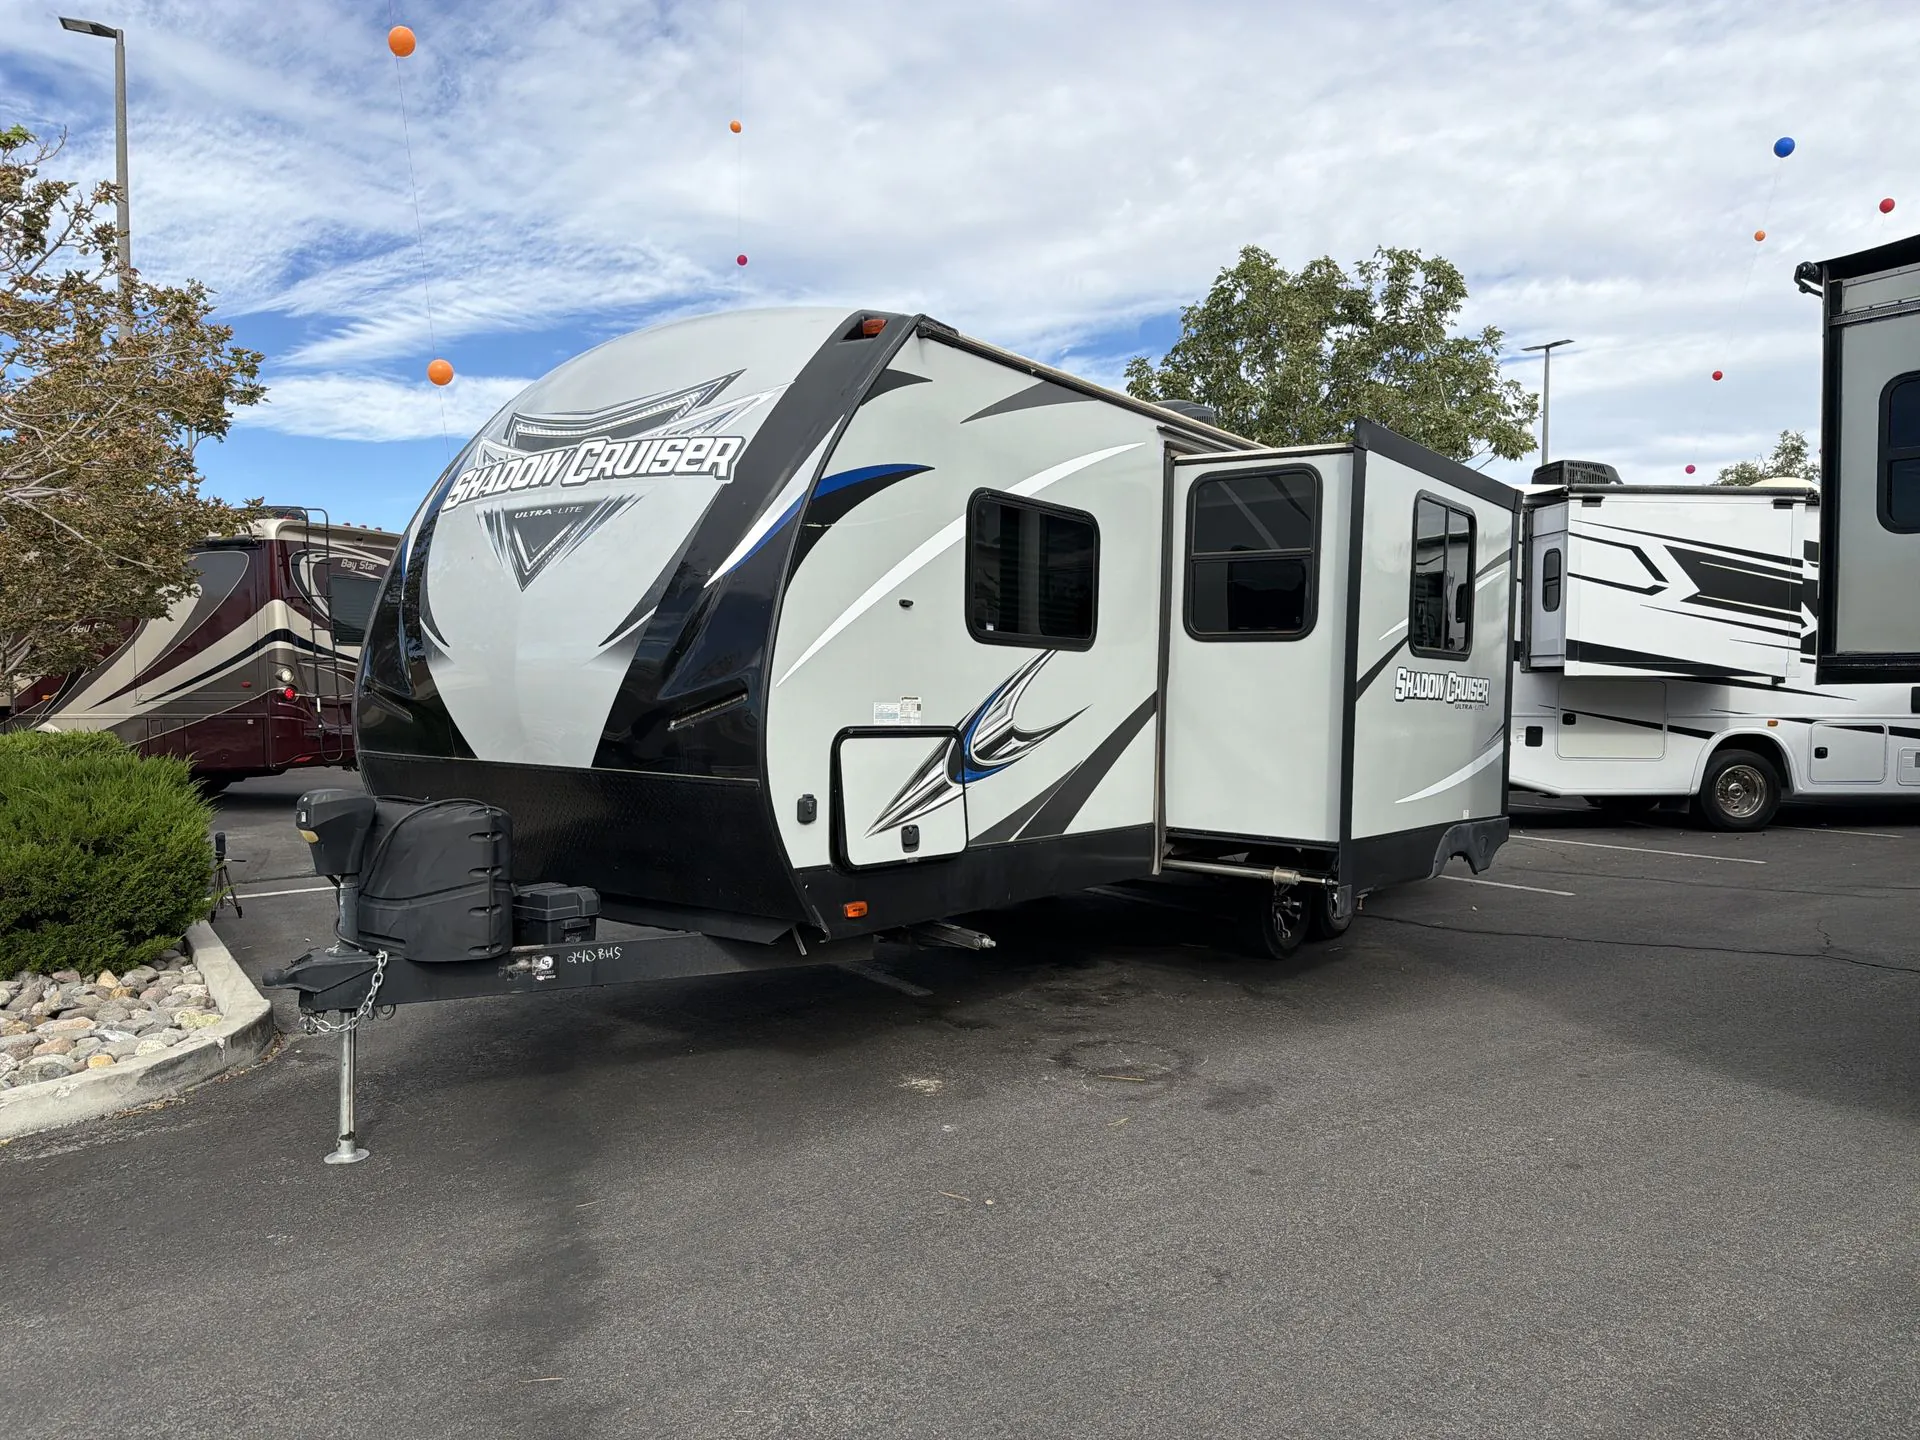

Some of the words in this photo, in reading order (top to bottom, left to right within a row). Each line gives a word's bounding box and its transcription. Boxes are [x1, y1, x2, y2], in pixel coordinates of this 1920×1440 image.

[441, 449, 574, 511] SHADOW
[560, 436, 746, 482] CRUISER
[514, 505, 585, 519] ULTRA-LITE
[340, 558, 357, 571] Bay
[358, 560, 378, 571] Star
[1395, 667, 1447, 701] SHADOW
[1446, 671, 1489, 705] CRUISER
